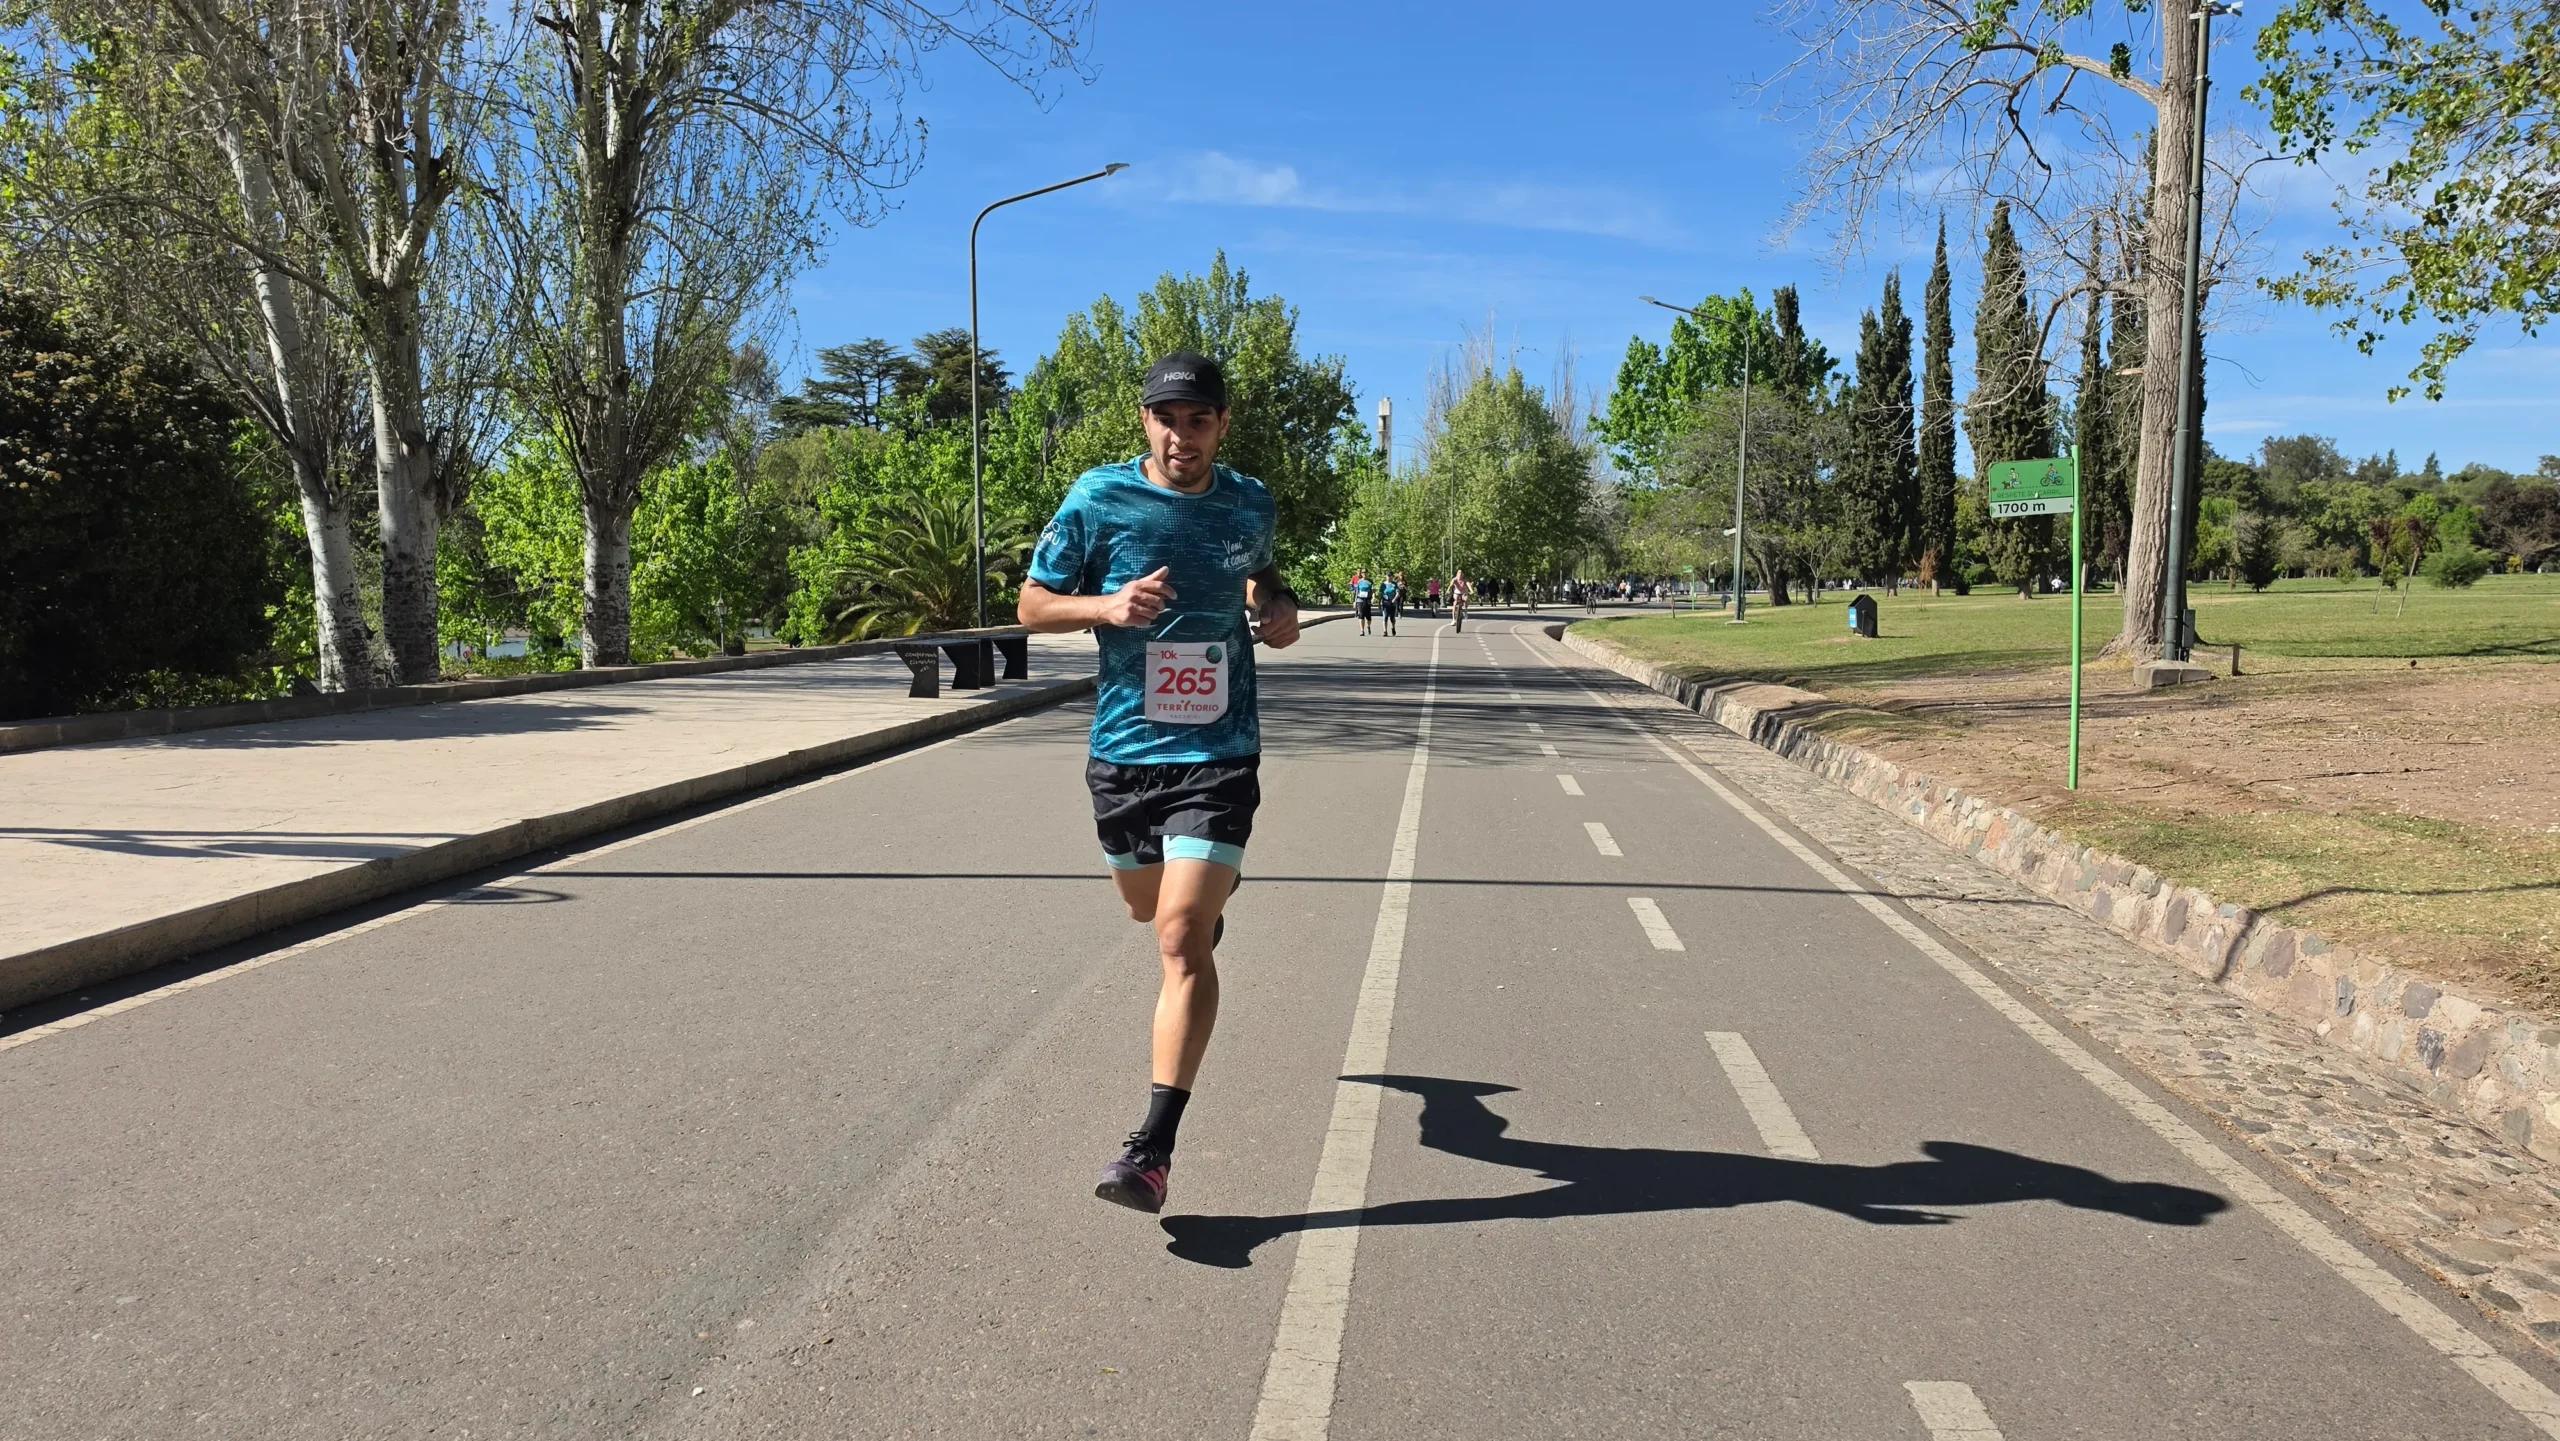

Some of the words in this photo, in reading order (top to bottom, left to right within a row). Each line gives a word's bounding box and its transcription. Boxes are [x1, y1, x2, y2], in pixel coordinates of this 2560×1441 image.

[1163, 371, 1196, 382] HOKA
[1997, 490, 2025, 498] RESPETE
[1998, 502, 2028, 514] 1700
[2033, 502, 2046, 511] m
[1160, 650, 1177, 659] 10k
[1155, 666, 1217, 695] 265
[1157, 700, 1219, 712] TERRITORIO
